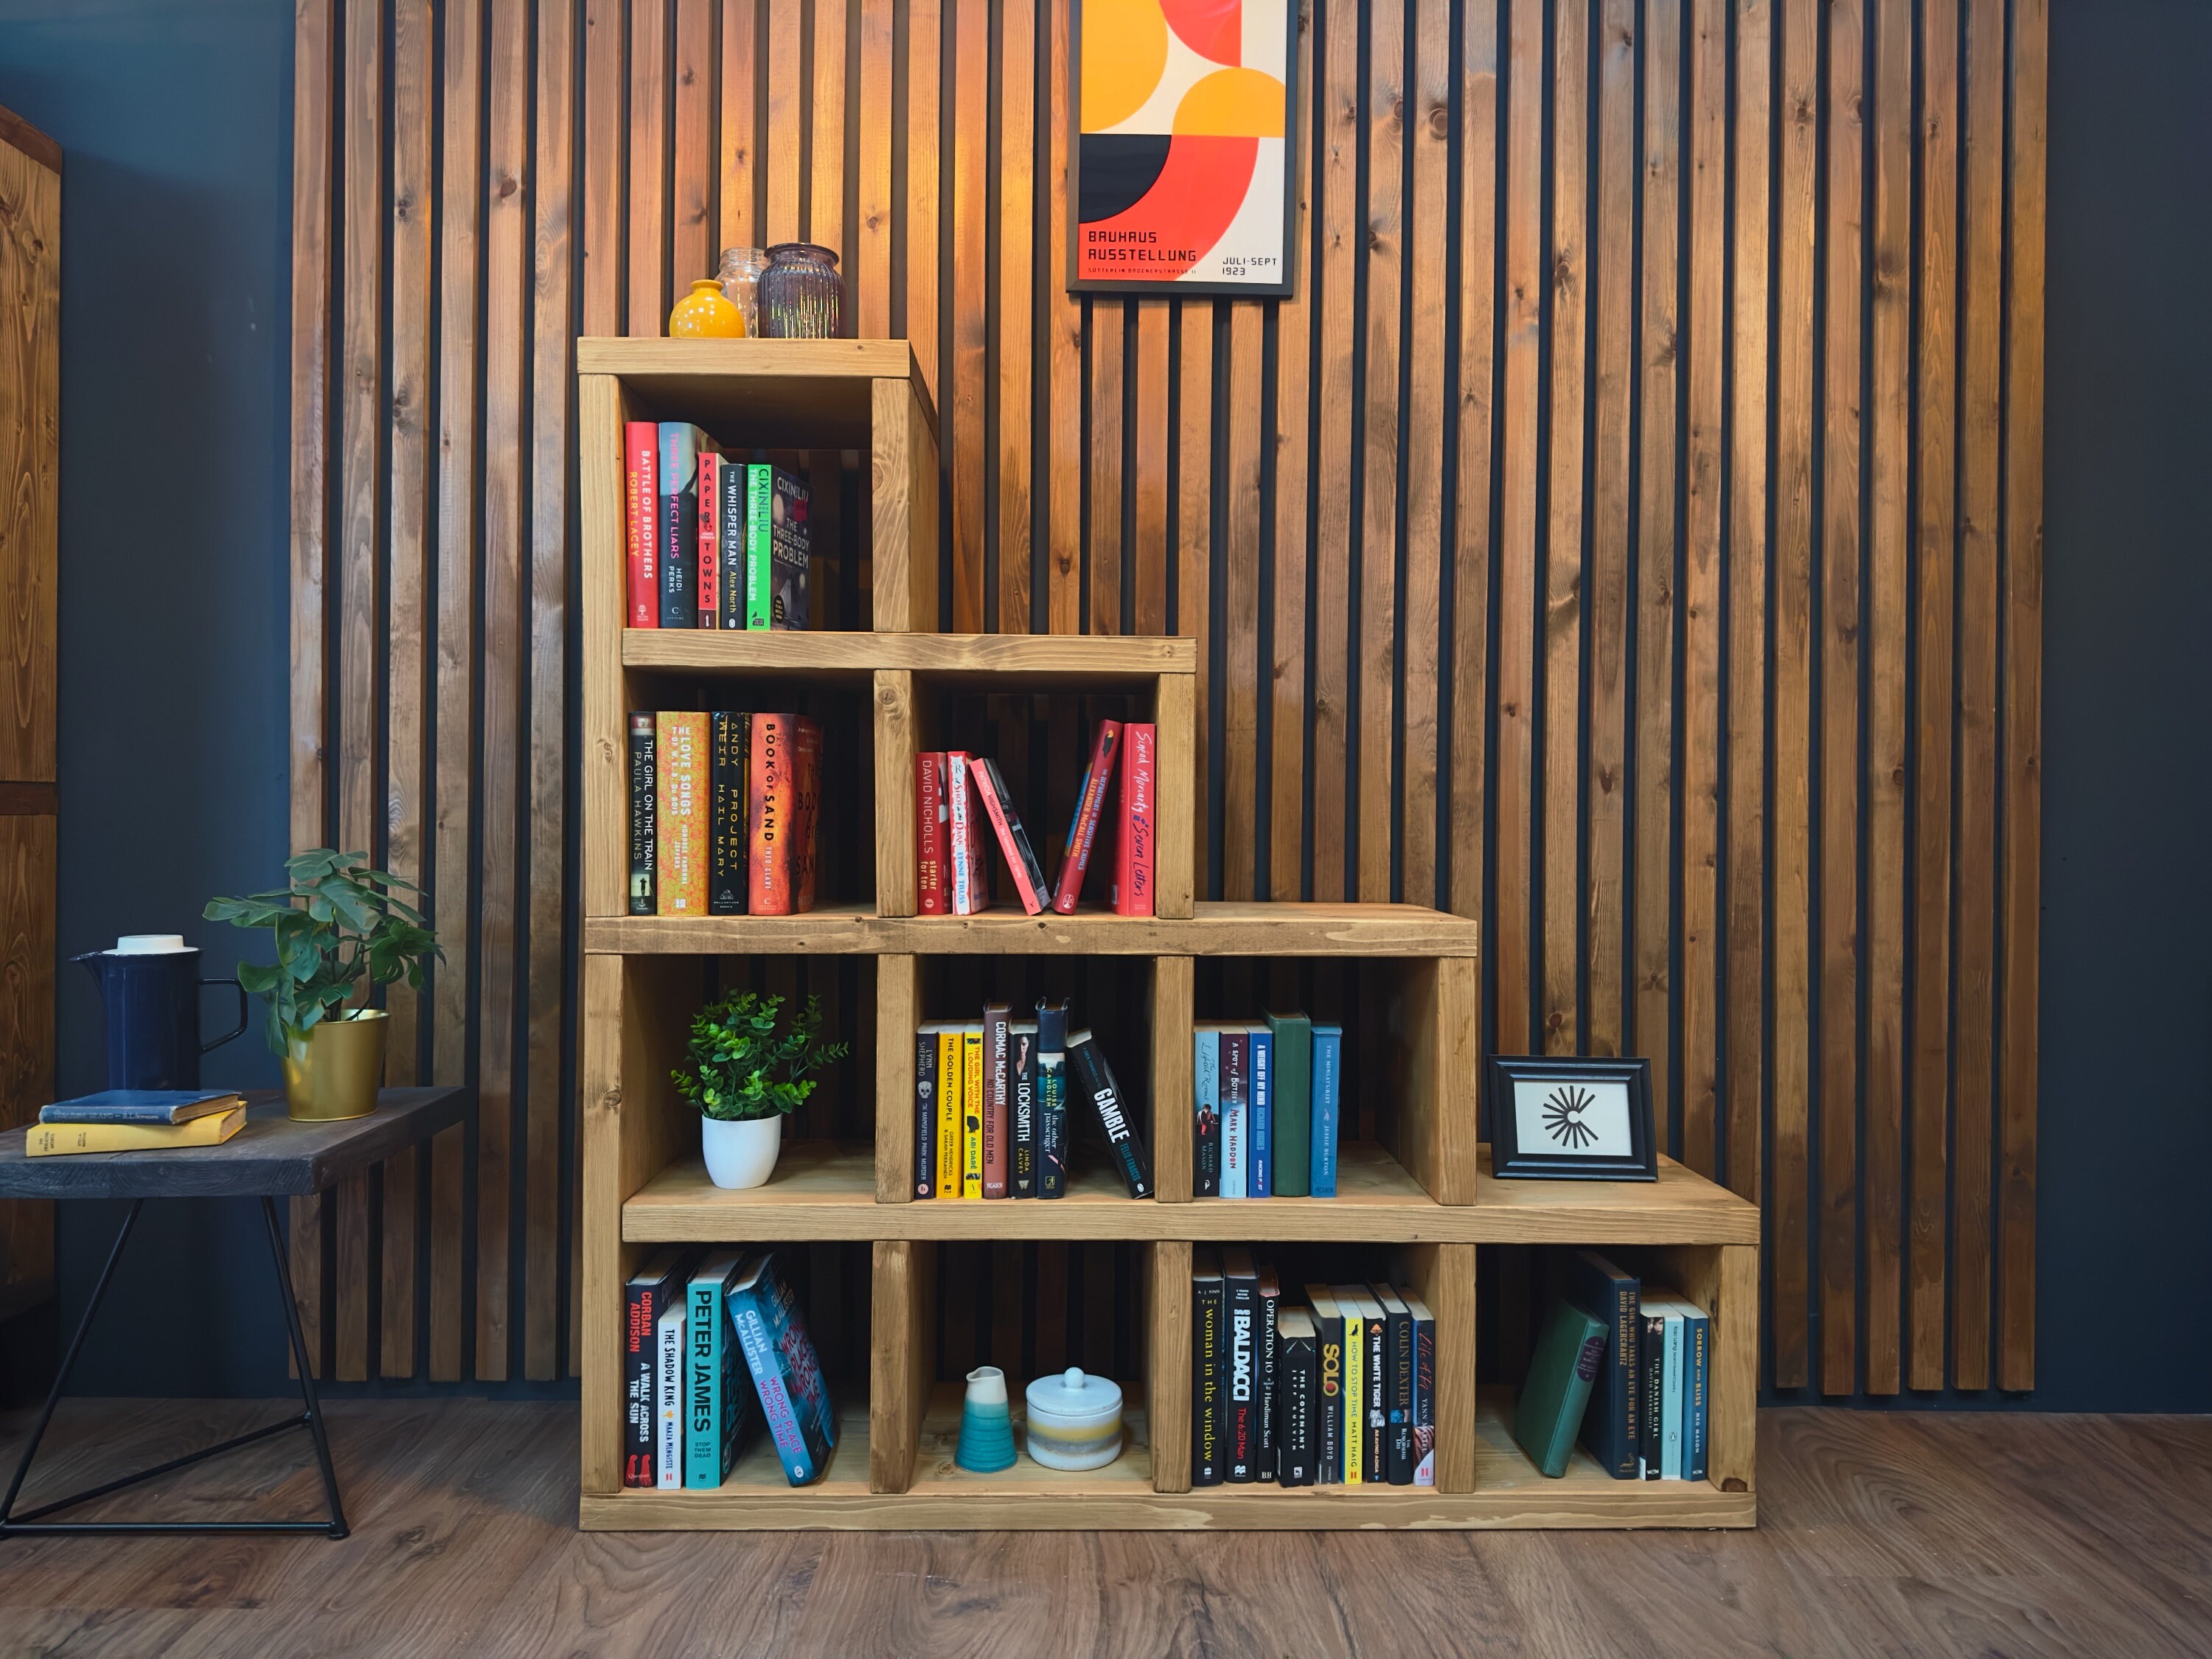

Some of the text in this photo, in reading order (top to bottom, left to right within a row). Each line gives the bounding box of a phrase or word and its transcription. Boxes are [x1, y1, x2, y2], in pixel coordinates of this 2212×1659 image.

[1088, 231, 1157, 243] BAUHAUS
[1088, 248, 1196, 262] AUSSTELLUNG
[1222, 257, 1277, 265] JULI-SEPT
[1222, 267, 1245, 276] 1923
[630, 472, 639, 557] ROBERT LACEY
[641, 451, 653, 579] BATTLE OF BROTHERS
[669, 433, 679, 559] THREE PERFECT LIARS
[728, 485, 737, 537] WHISPER
[758, 469, 768, 532] CIXIN LIU
[728, 540, 737, 566] MAN
[749, 469, 757, 601] THE THREE-BODY PROBLEM
[773, 524, 810, 549] THREE-BODY
[773, 540, 809, 569] PROBLEM
[672, 726, 690, 734] THE
[718, 721, 726, 766] WEIR
[681, 737, 691, 815] LOVE SONGS
[634, 801, 642, 860] HAWKINS
[644, 740, 653, 870] THE GIRL ON THE TRAIN
[922, 760, 933, 854] DAVID NICHOLLS
[1072, 778, 1098, 858] ALEXANDER McCALL SMITH
[1133, 823, 1149, 858] Seven
[1133, 861, 1150, 897] Letters
[987, 1079, 994, 1088] NO
[995, 1021, 1006, 1105] CORMAC McCARTHY
[1018, 1083, 1030, 1141] LOCKSMITH
[1043, 1113, 1052, 1153] passenger
[1093, 1088, 1130, 1144] GAMBLE
[986, 1135, 994, 1148] OLD
[986, 1150, 994, 1164] MEN
[1229, 1109, 1239, 1169] MARK HADDON
[630, 1302, 639, 1352] ADDISON
[641, 1292, 652, 1336] CORBAN
[745, 1310, 768, 1353] GILLIAN
[694, 1290, 712, 1432] PETER JAMES
[734, 1313, 762, 1375] McALLISTER
[1233, 1316, 1251, 1401] BALDACCI
[1399, 1321, 1410, 1405] COLIN DEXTER
[1619, 1315, 1627, 1366] LAGERCRANTZ
[664, 1329, 675, 1406] THE SHADOW KING
[1204, 1309, 1216, 1461] woman in the window
[1323, 1343, 1340, 1397] SOLO
[1352, 1364, 1357, 1375] TO
[1628, 1369, 1635, 1379] AN
[630, 1380, 639, 1424] THE SUN
[639, 1363, 650, 1442] A WALK ACROSS
[759, 1380, 789, 1448] WRONG TIME
[769, 1376, 802, 1454] WRONG PLACE
[1264, 1393, 1272, 1428] Hardiman
[1628, 1413, 1635, 1424] AN
[665, 1422, 673, 1469] MAAZA MENGISTE
[1237, 1408, 1247, 1459] The 6:20 Man
[1263, 1430, 1271, 1448] Scott
